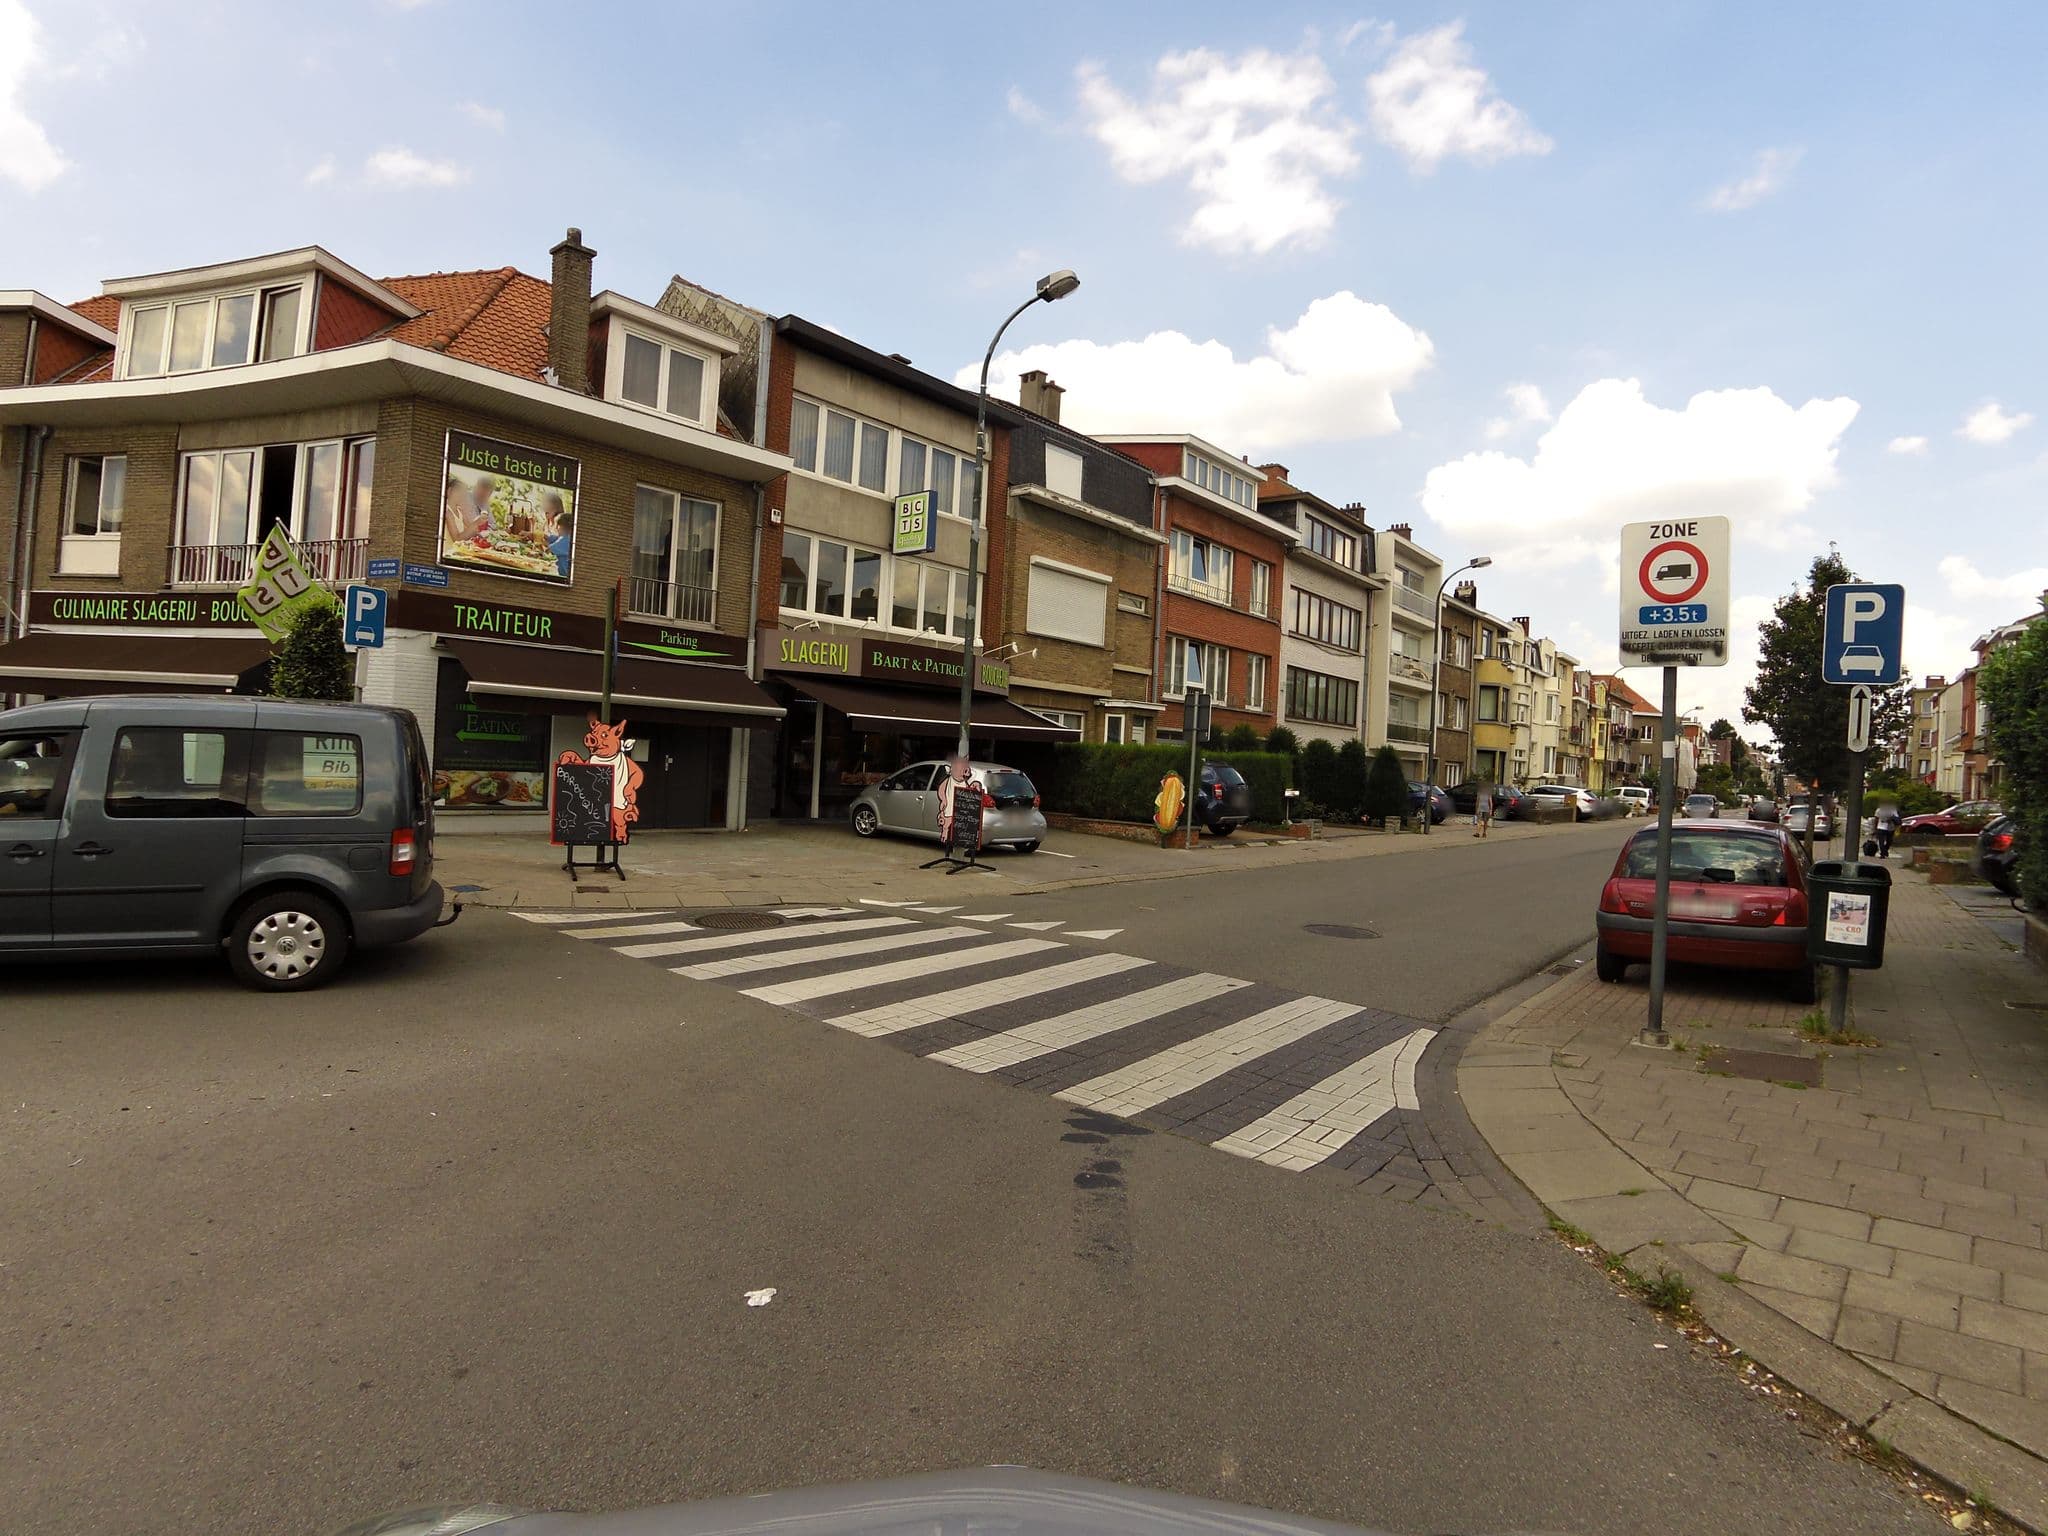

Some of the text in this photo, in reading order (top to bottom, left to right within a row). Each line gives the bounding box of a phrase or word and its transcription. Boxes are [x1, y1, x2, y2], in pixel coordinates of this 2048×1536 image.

[458, 442, 500, 469] Juste
[504, 454, 542, 479] taste
[546, 462, 557, 483] it
[1649, 521, 1698, 539] ZONE
[53, 598, 129, 620] CULINAIRE
[132, 599, 197, 622] SLAGERIJ
[355, 590, 378, 622] P
[1843, 592, 1886, 643] P
[453, 604, 552, 639] TRAITEUR
[1653, 629, 1679, 639] LADEN
[1681, 629, 1692, 638] EN
[1695, 628, 1725, 638] LOSSEN
[660, 630, 698, 650] Parking
[781, 638, 849, 673] SLAGERIJ
[872, 651, 910, 669] BART
[911, 659, 922, 671] &
